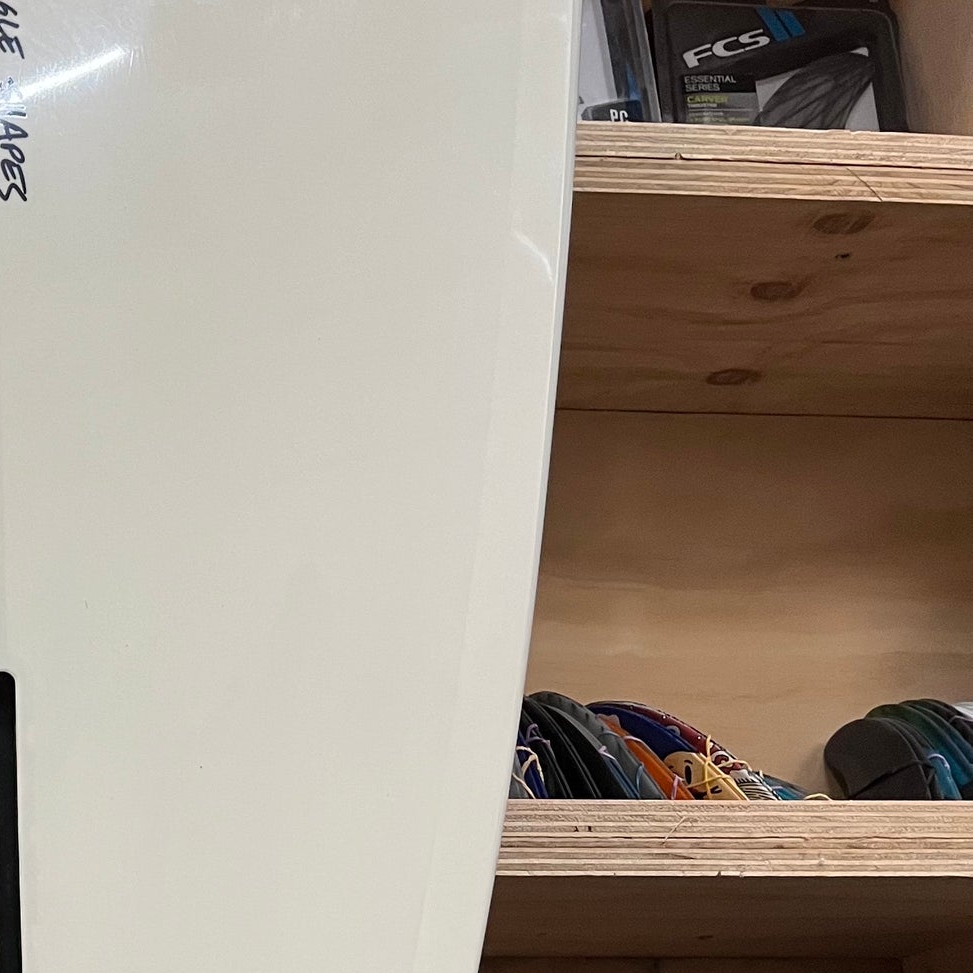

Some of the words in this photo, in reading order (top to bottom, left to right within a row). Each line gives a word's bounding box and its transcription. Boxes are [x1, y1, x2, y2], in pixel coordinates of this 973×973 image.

[683, 28, 771, 69] FCS
[684, 75, 736, 83] ESSENTIAL
[685, 83, 721, 92] SERIES
